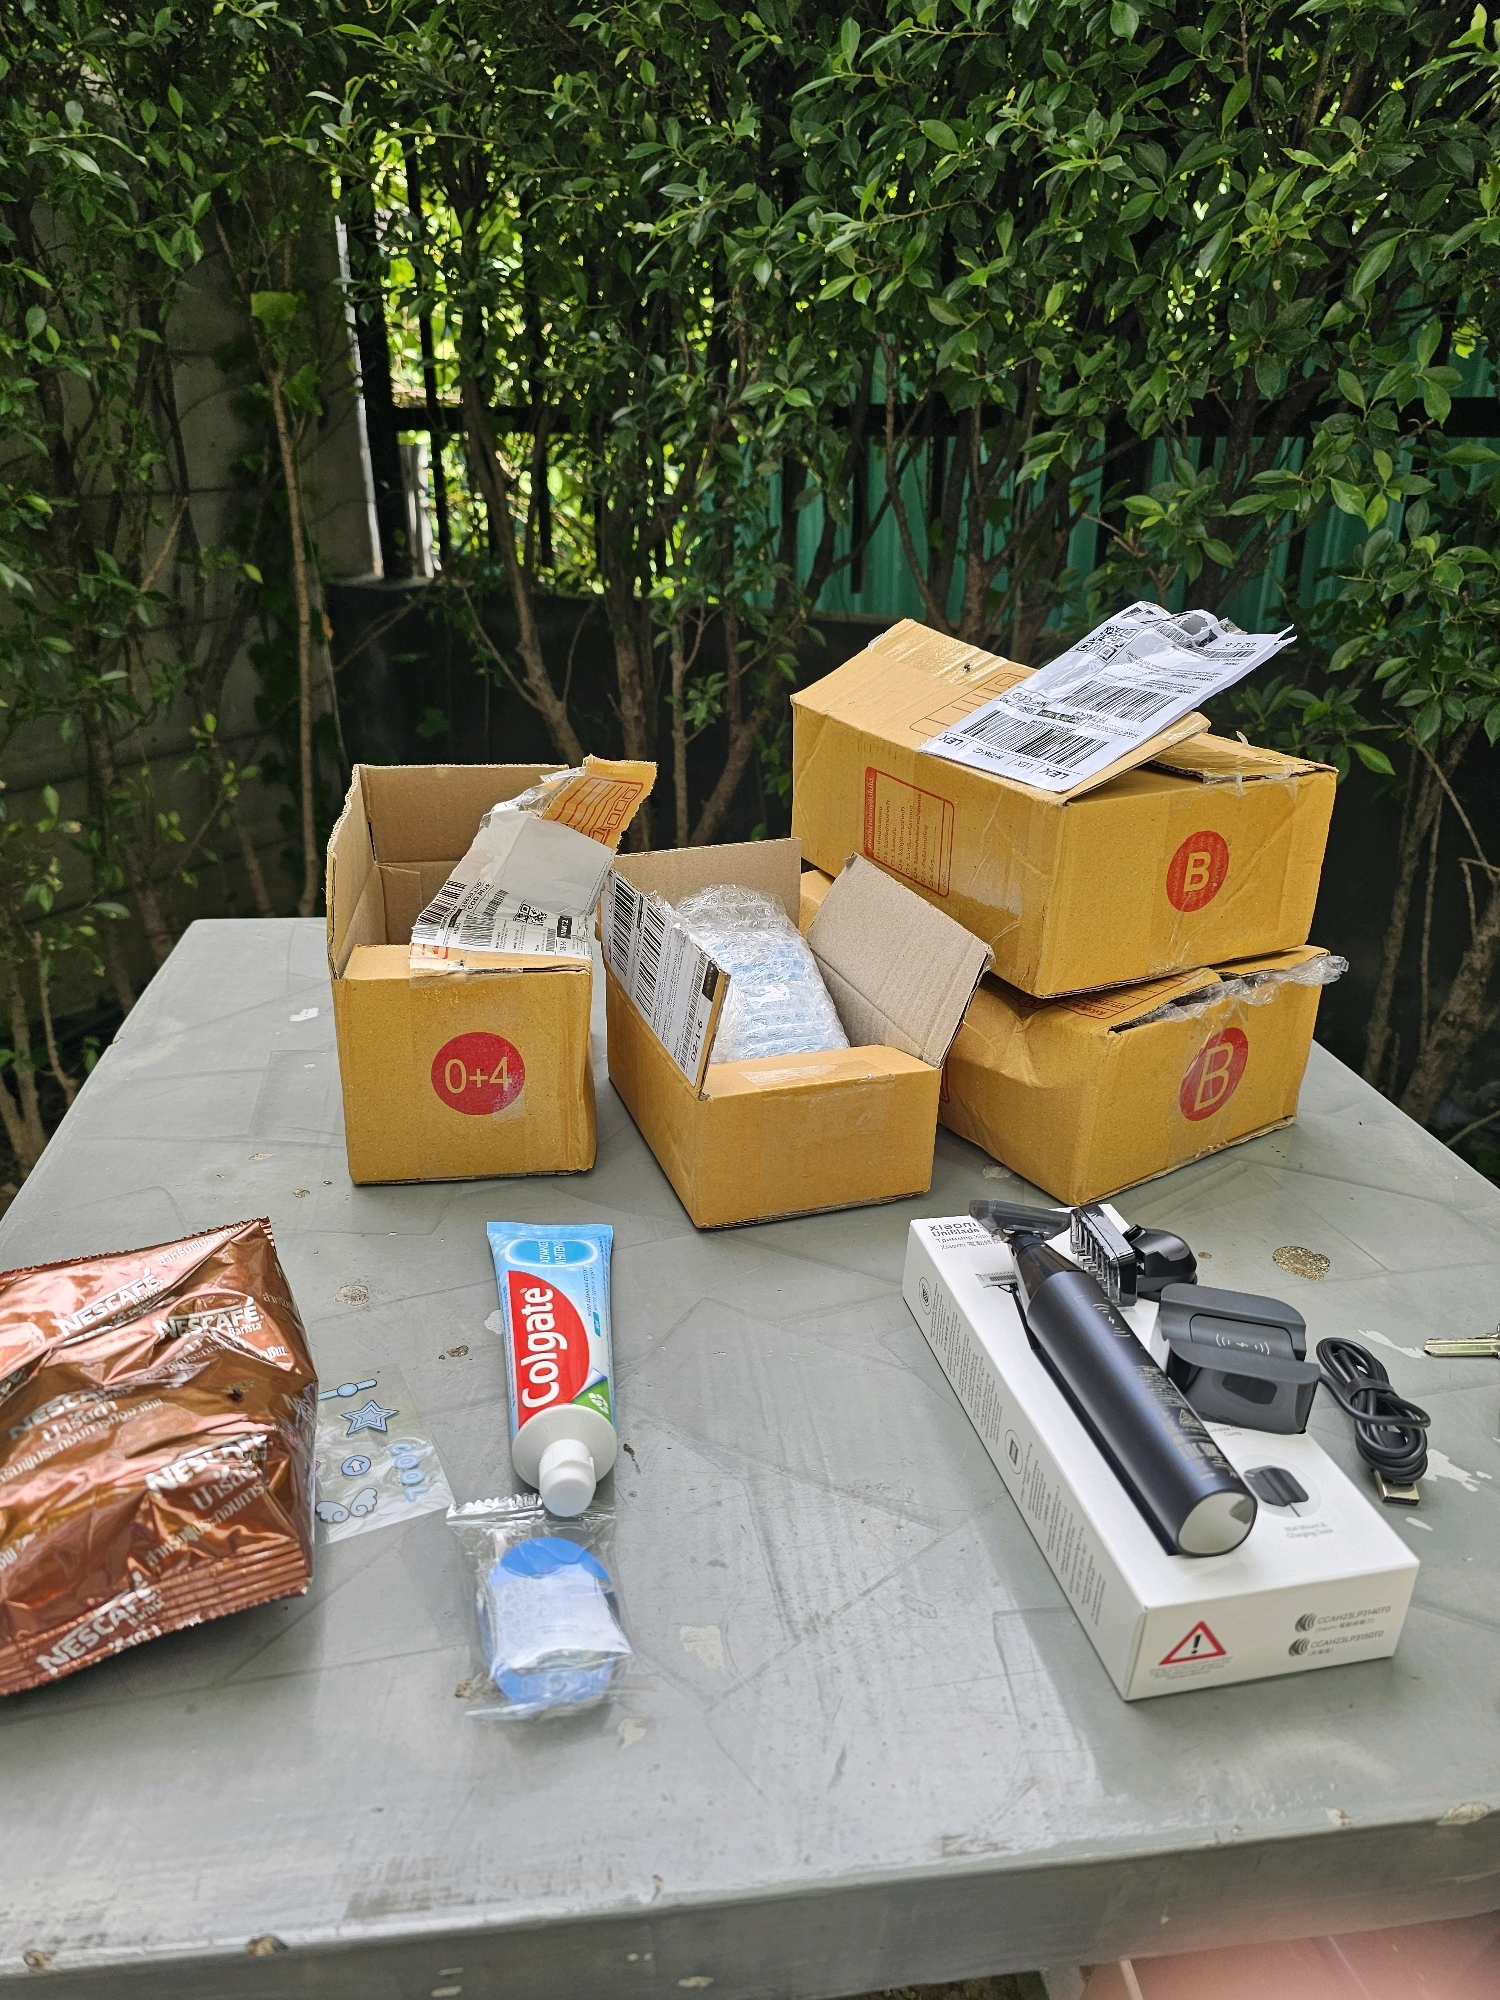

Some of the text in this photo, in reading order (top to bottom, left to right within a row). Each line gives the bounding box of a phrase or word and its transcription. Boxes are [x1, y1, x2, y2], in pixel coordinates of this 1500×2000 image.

[938, 734, 964, 747] LEX
[1039, 767, 1070, 780] LEX
[1183, 851, 1212, 893] B
[1193, 1042, 1234, 1112] B
[931, 1228, 980, 1237] UniBlade
[57, 1267, 161, 1338] NESCAFÉ
[520, 1287, 568, 1409] Colgate
